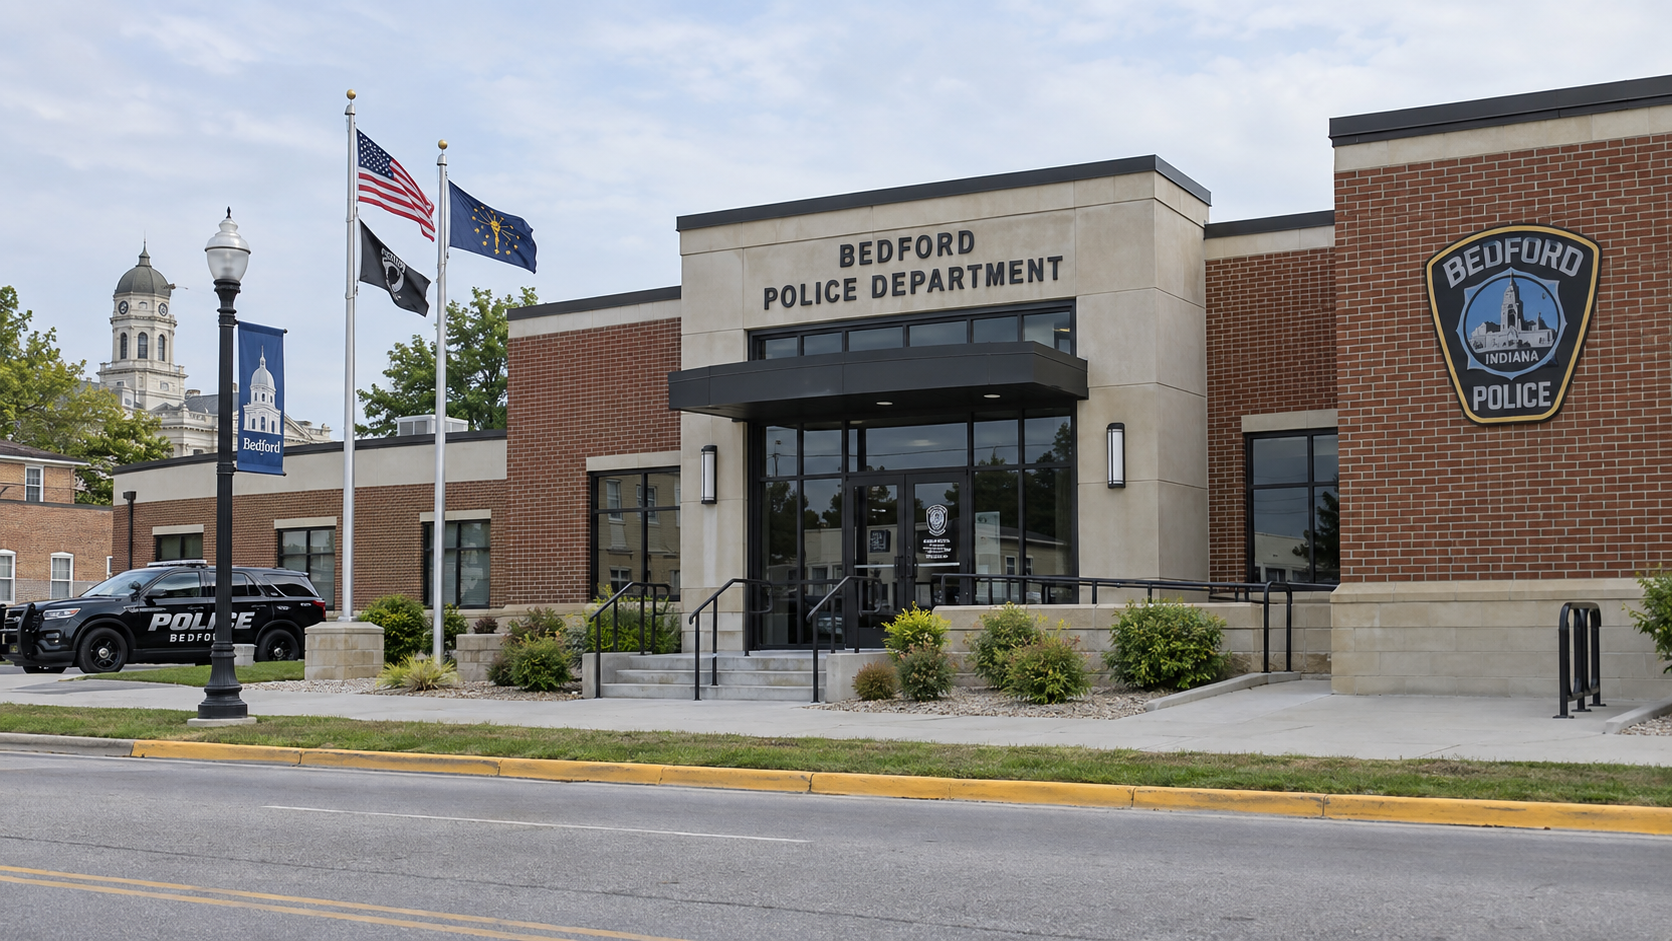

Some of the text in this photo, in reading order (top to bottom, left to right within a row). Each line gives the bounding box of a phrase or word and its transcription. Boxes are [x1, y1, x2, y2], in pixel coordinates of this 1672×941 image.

[839, 230, 975, 268] BEDFORD
[1442, 236, 1585, 289] BEDFORD
[763, 255, 1063, 310] POLICE DEPARTMENT
[1485, 350, 1540, 365] INDIANA
[1472, 381, 1552, 411] POLICE
[243, 437, 280, 453] Bedford
